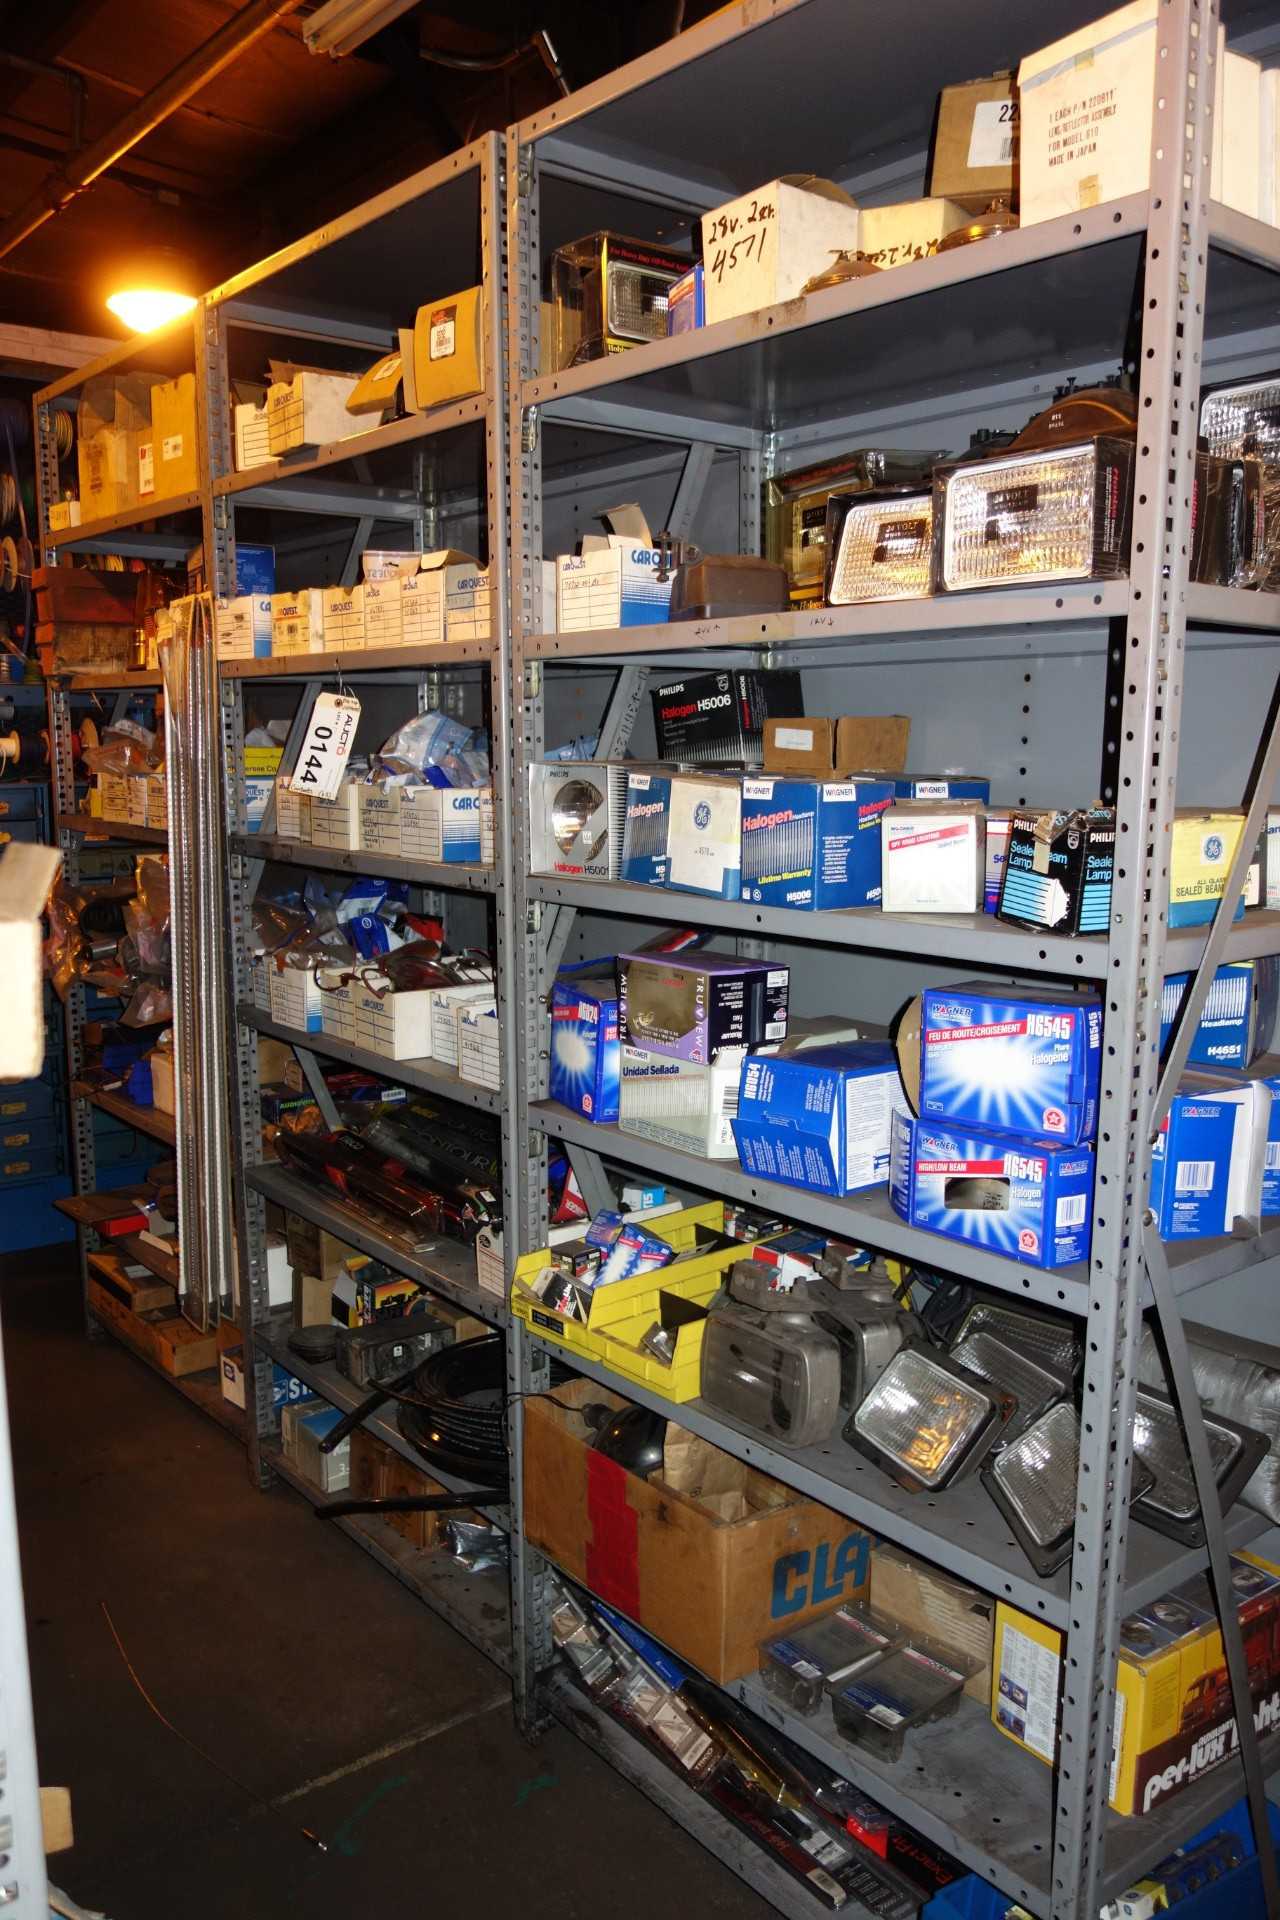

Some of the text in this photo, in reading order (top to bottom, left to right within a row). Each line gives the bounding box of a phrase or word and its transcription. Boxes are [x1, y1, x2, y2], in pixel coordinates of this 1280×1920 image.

[1055, 107, 1071, 121] EACH
[1091, 104, 1117, 121] ASSEMBLY
[1062, 132, 1083, 148] MODEL
[1048, 142, 1097, 167] MADE IN JAPAN
[712, 228, 767, 283] 4571
[457, 576, 489, 591] CARQUEST
[659, 683, 685, 697] PHILIPS
[661, 694, 732, 719] Halogen H5006
[300, 725, 333, 784] 0144
[745, 786, 771, 795] WAGNER
[825, 788, 853, 797] WAGNER
[918, 786, 946, 794] WAGNER
[626, 801, 665, 818] Halogen
[858, 799, 892, 816] Halogen
[742, 810, 793, 830] Halogen
[1011, 841, 1035, 857] Seale
[553, 862, 583, 875] Halogen
[1009, 855, 1033, 870] Lamp
[1087, 855, 1113, 869] Seale
[758, 868, 812, 885] Lifetime Warranty
[1085, 869, 1112, 882] Lamp
[786, 889, 812, 902] H5006
[866, 887, 882, 900] H50
[1175, 885, 1202, 897] SEALED
[932, 1003, 973, 1016] WAGNER
[929, 1013, 1071, 1041] FEU DE ROUTE/CROISEMENT H6545
[1088, 1011, 1100, 1049] H6545
[1201, 1018, 1244, 1028] Headlamp
[625, 1048, 648, 1060] WAGNER
[1207, 1044, 1242, 1057] H4651
[623, 1065, 680, 1077] Unidad Sellada
[744, 1063, 761, 1100] H6054
[921, 1136, 957, 1151] WAGNER
[918, 1153, 1043, 1183] HIGH/LOW BEAM H6545
[1143, 1730, 1226, 1814] per-lux
